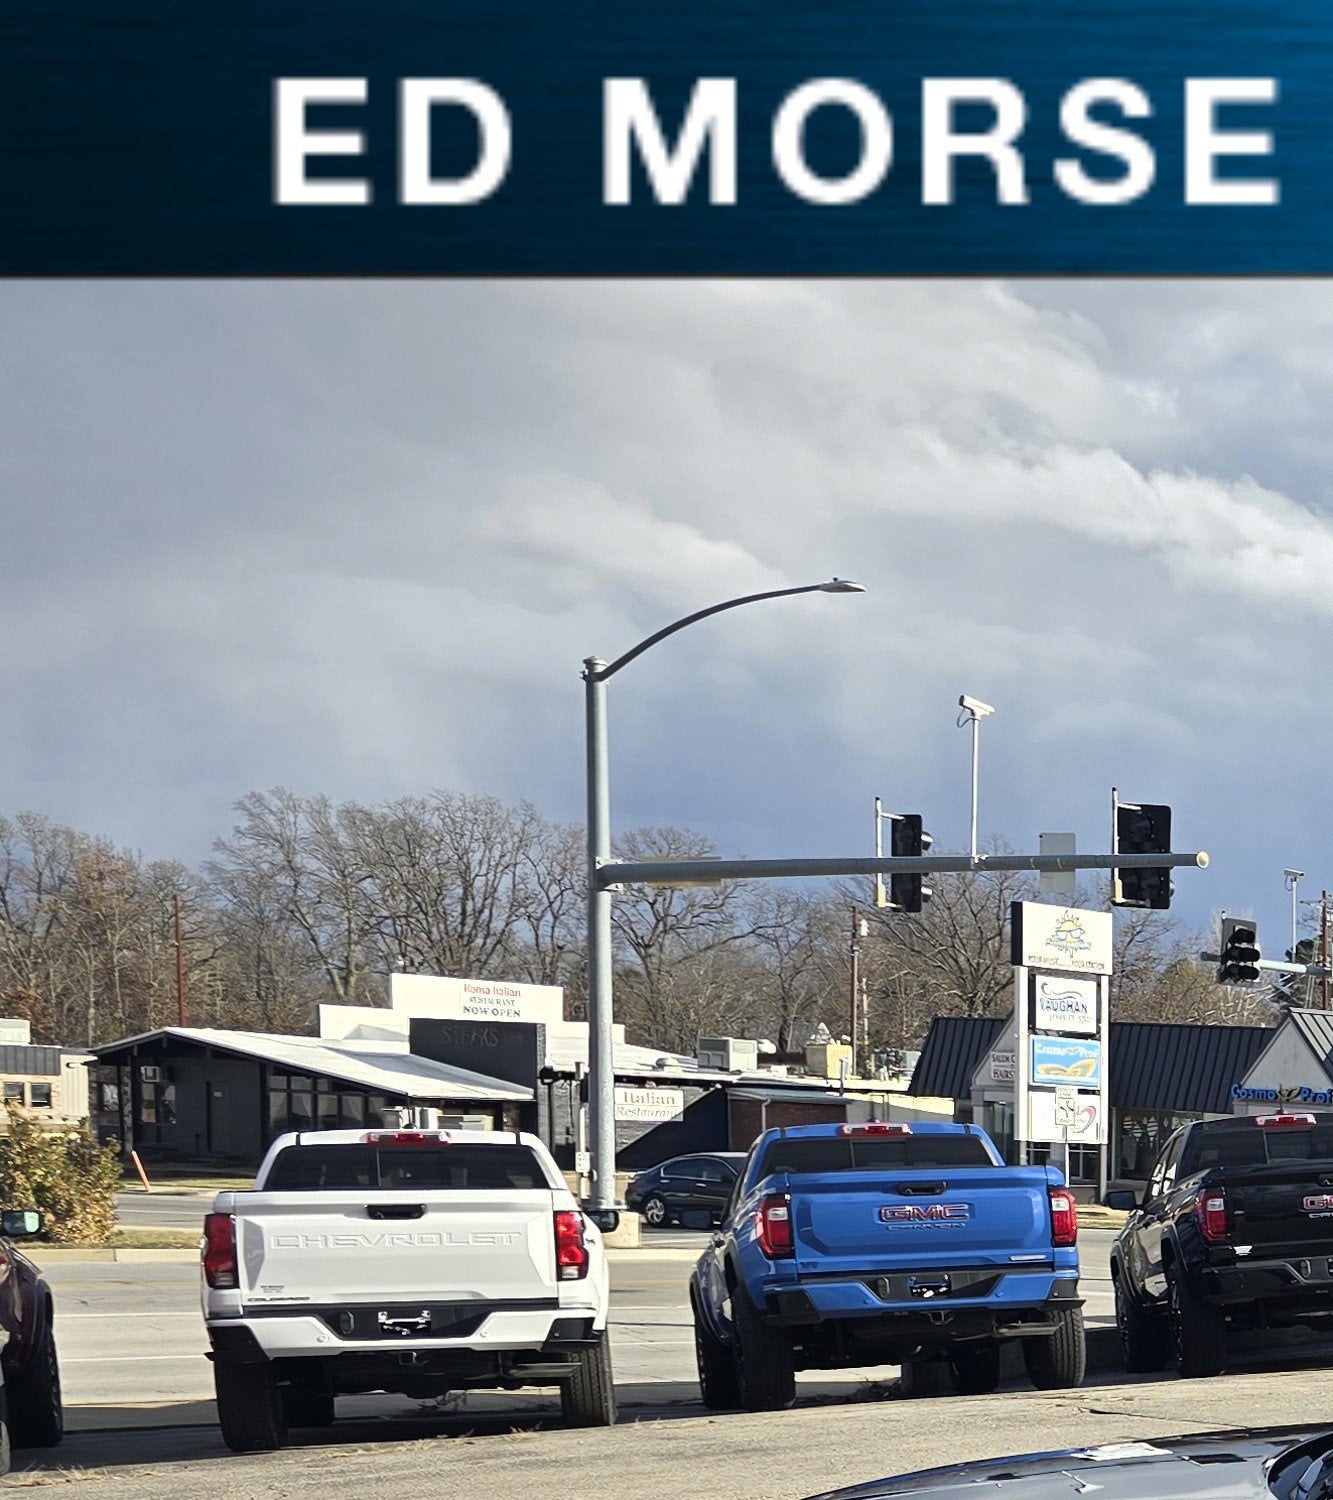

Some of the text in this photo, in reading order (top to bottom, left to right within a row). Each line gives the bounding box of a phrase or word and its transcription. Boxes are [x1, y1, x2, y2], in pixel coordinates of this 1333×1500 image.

[463, 1005, 521, 1018] NOW OPEN
[624, 1091, 676, 1105] Italian
[1230, 1083, 1278, 1101] Cosmo
[616, 1106, 678, 1118] Restauran
[880, 1203, 969, 1222] GMC
[270, 1231, 522, 1250] CHEVROLET
